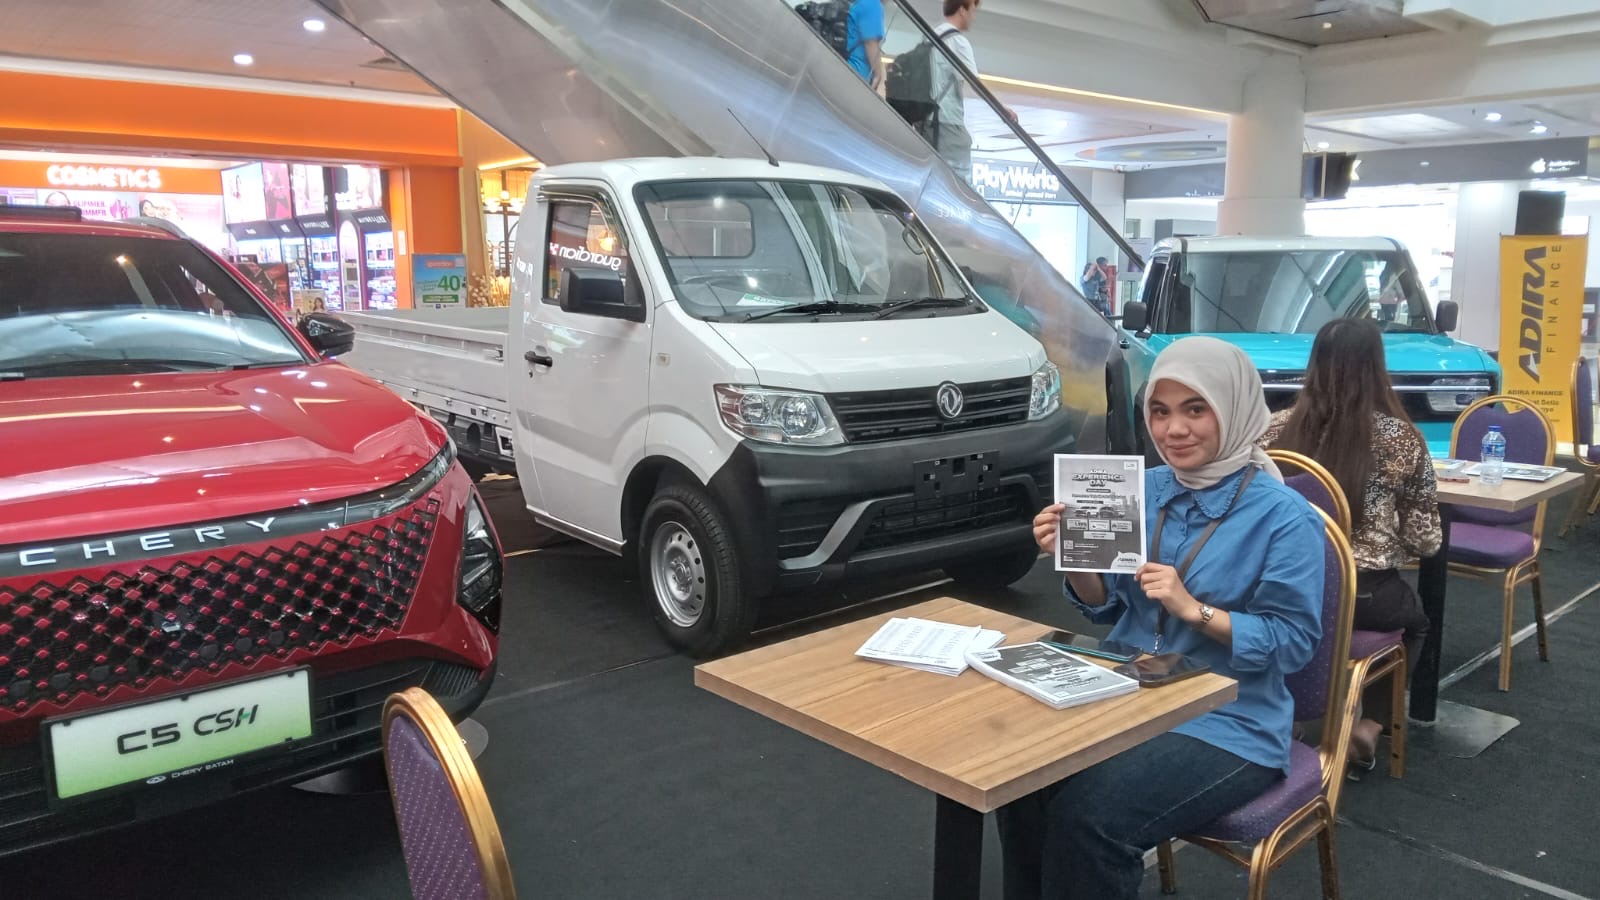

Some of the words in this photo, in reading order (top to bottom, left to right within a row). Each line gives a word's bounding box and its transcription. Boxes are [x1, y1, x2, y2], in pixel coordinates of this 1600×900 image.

[46, 165, 161, 189] COSMETICS
[972, 163, 1060, 193] PlayWorks
[438, 274, 461, 292] 40
[1546, 245, 1562, 354] FINANCE
[1518, 246, 1547, 384] ADIRA
[1531, 389, 1564, 397] FINANCE
[1071, 472, 1126, 482] EXPERIENCE
[1089, 479, 1106, 487] DAY
[18, 516, 276, 567] CHERY
[116, 722, 181, 756] C5
[193, 703, 260, 737] CSH
[170, 766, 203, 779] CHERY
[204, 758, 235, 771] BATAM
